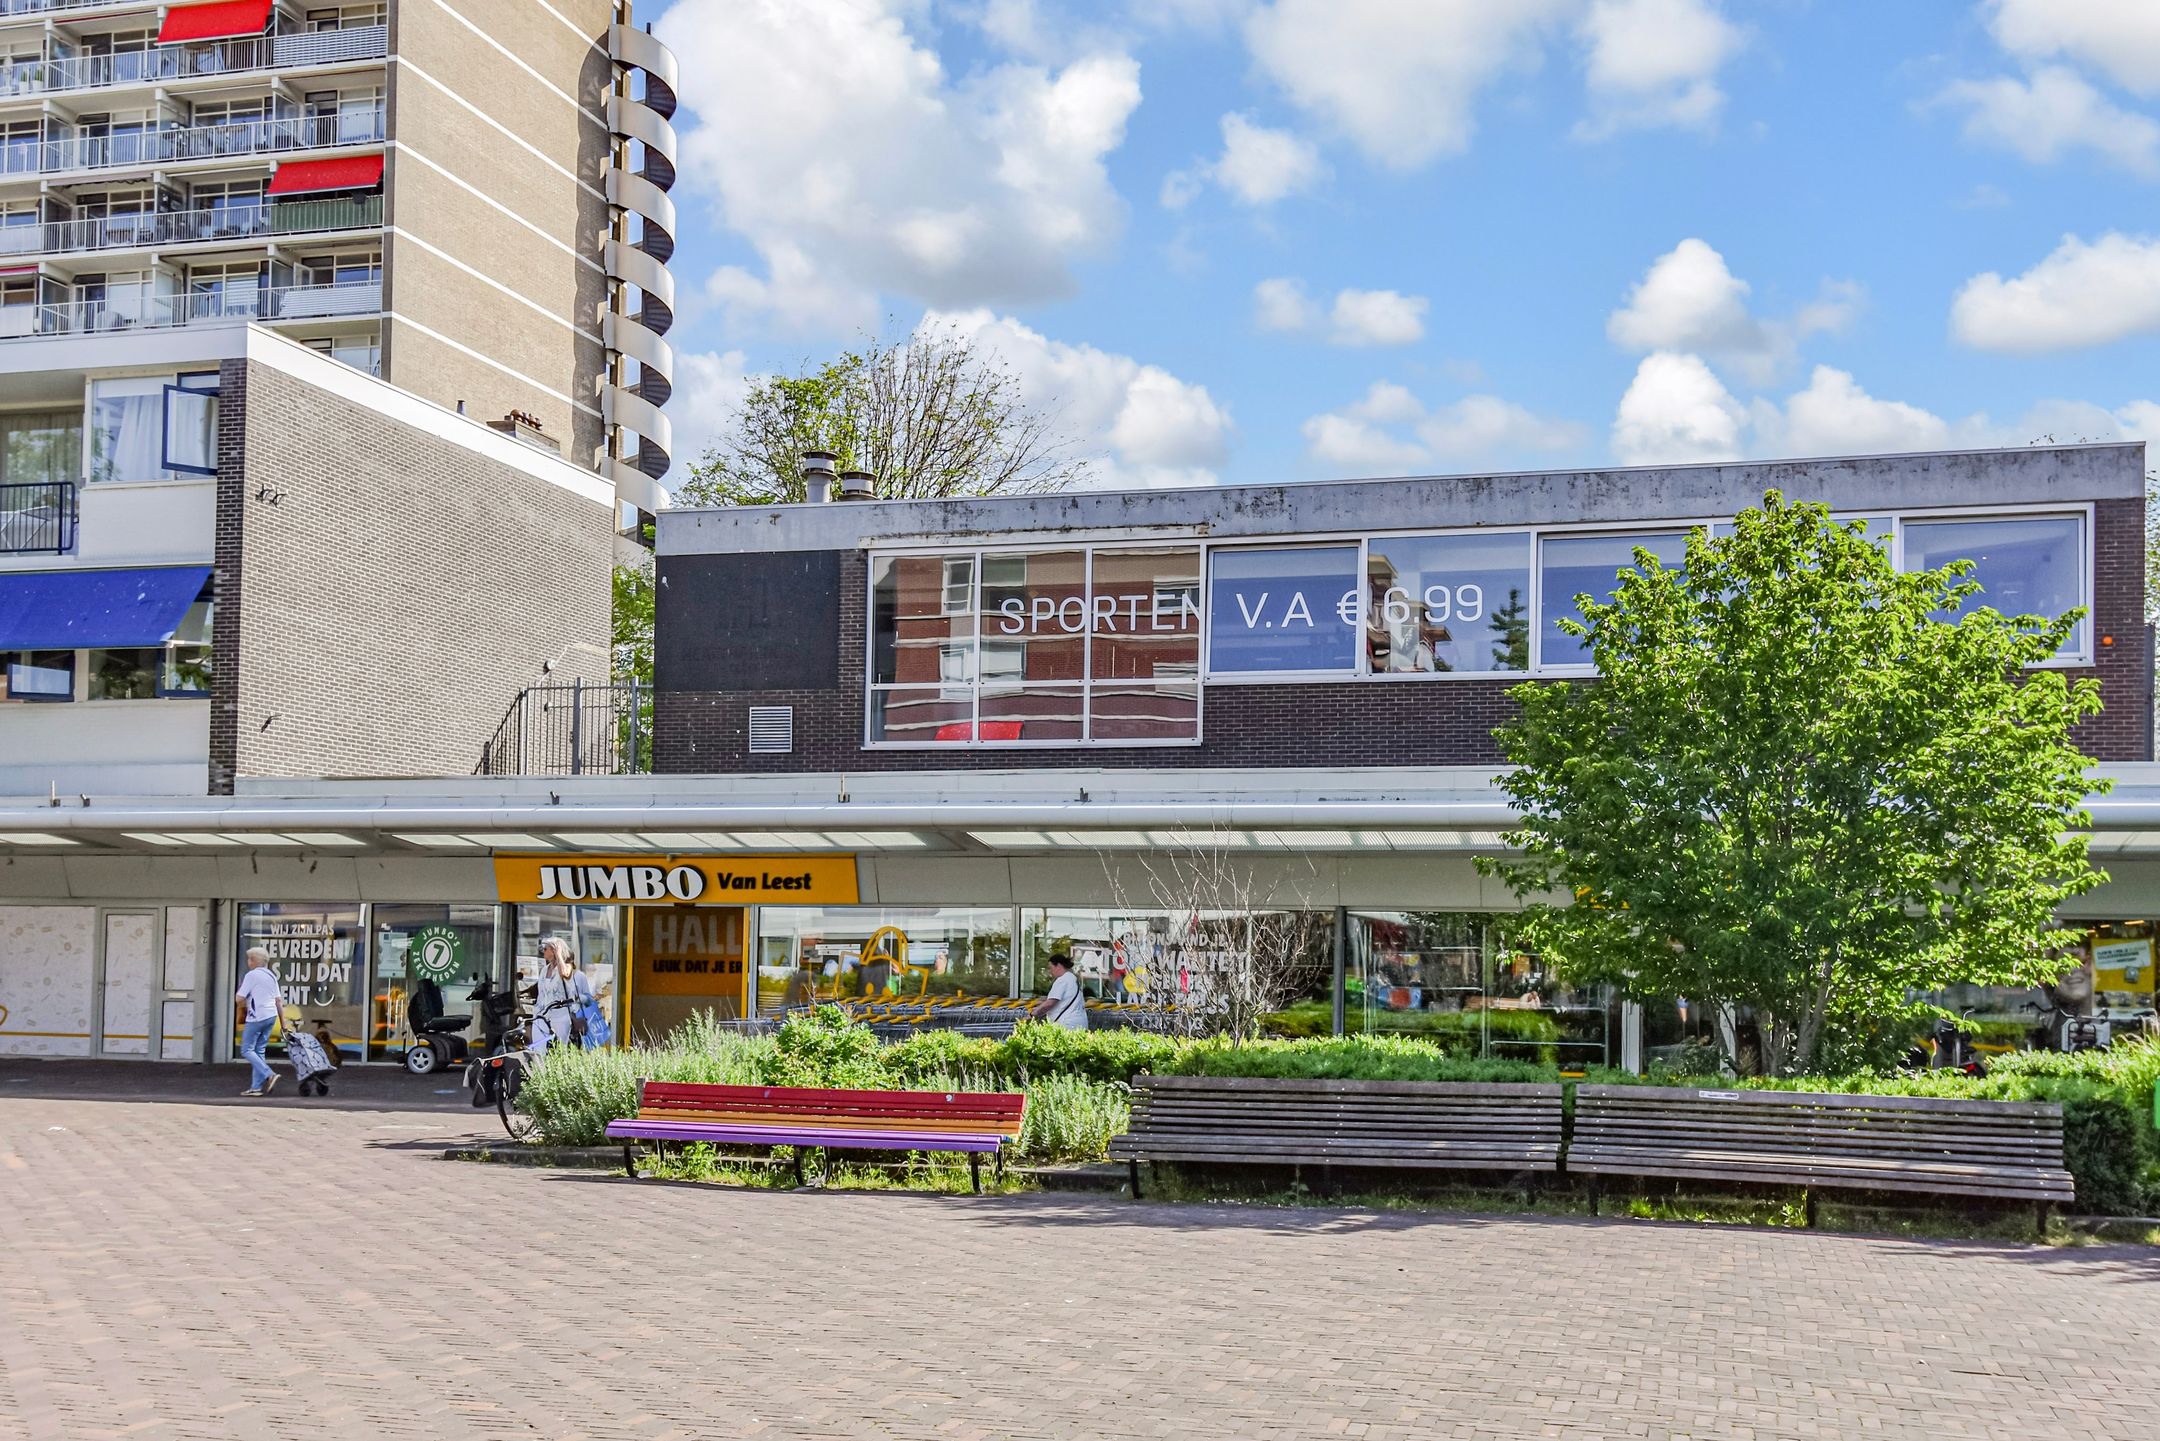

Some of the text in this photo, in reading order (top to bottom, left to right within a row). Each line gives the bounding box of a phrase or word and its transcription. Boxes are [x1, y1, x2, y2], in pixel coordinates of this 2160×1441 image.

[1000, 593, 1200, 634] SPORTEN
[1383, 584, 1483, 624] 6.99
[536, 865, 812, 900] JUMBO Van Leest
[270, 923, 335, 936] WIJ ZIJN PAS
[422, 926, 461, 947] JUMBO'S
[432, 943, 446, 965] 7
[285, 962, 312, 983] JIJ
[317, 963, 352, 983] DAT
[412, 951, 460, 982] ZEKERHEDEN
[653, 959, 681, 973] LEUK
[685, 960, 709, 973] DAT
[711, 961, 725, 973] JE
[279, 985, 311, 1005] ENT
